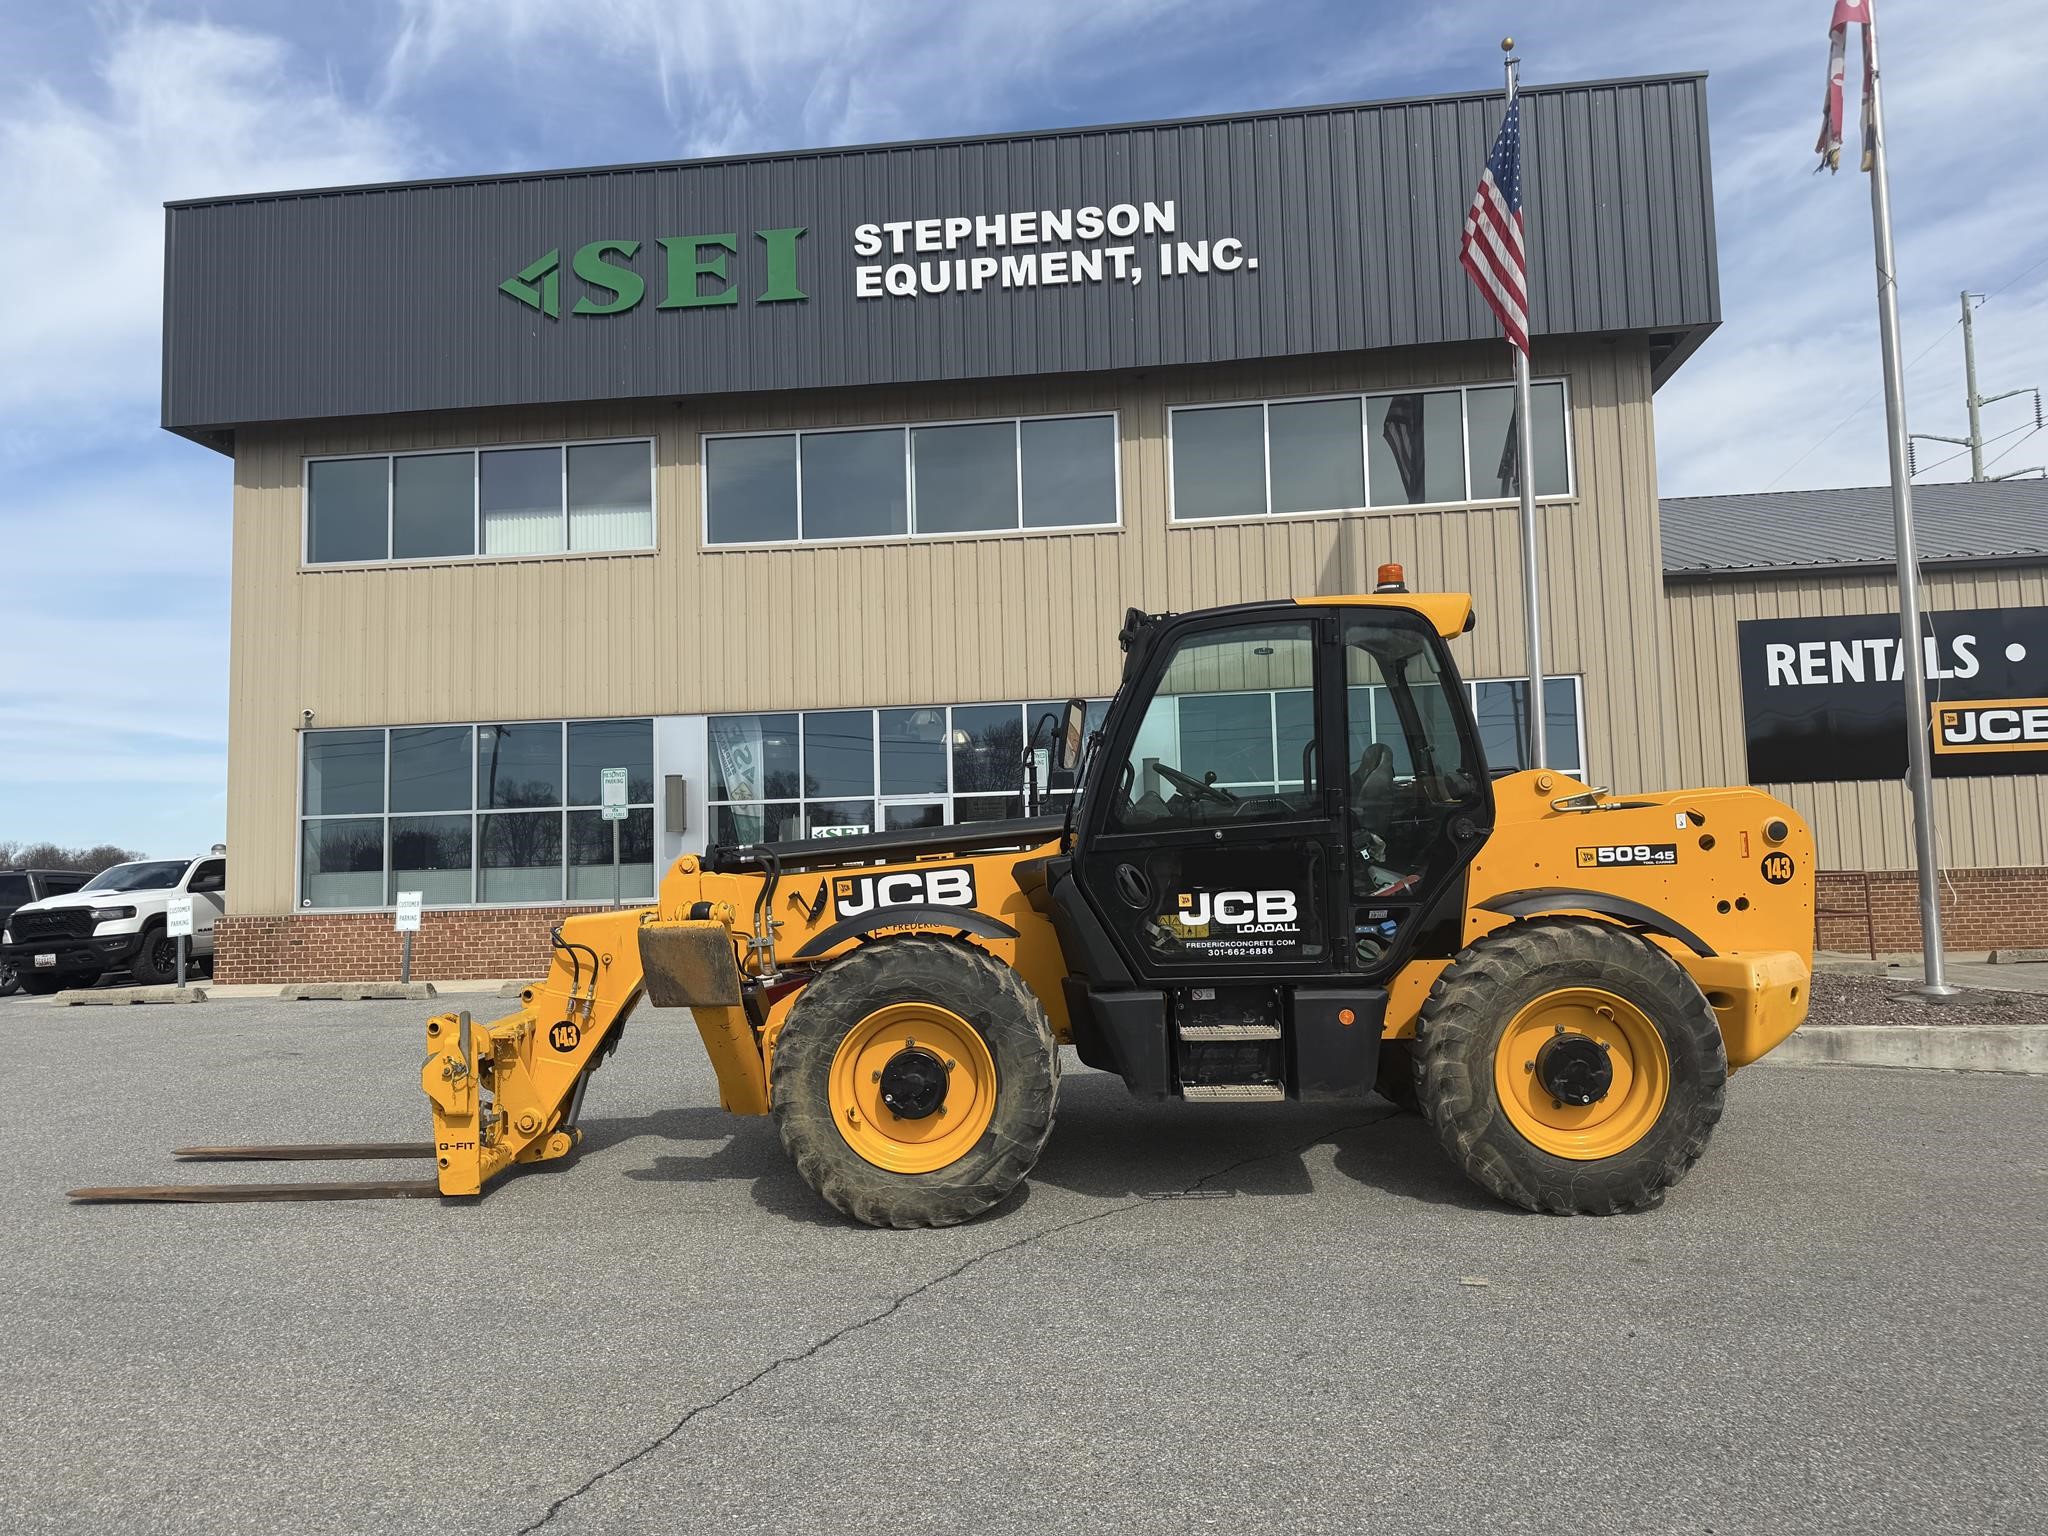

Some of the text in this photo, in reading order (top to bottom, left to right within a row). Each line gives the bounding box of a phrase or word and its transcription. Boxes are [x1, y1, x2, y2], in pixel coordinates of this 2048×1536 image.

[854, 200, 1176, 257] STEPHENSON
[571, 226, 810, 315] SEI
[856, 238, 1259, 298] EQUIPMENT, INC.
[1598, 846, 1675, 863] 509-45
[1765, 857, 1791, 880] 143
[838, 869, 974, 917] JCB
[1178, 890, 1298, 926] JCB
[1236, 923, 1301, 934] LOADALL
[1186, 939, 1296, 949] FREDERICKCONCRETE.COM
[1207, 947, 1274, 957] 301-662-6886
[552, 1026, 578, 1048] 143
[439, 1142, 475, 1151] Q-FIT
